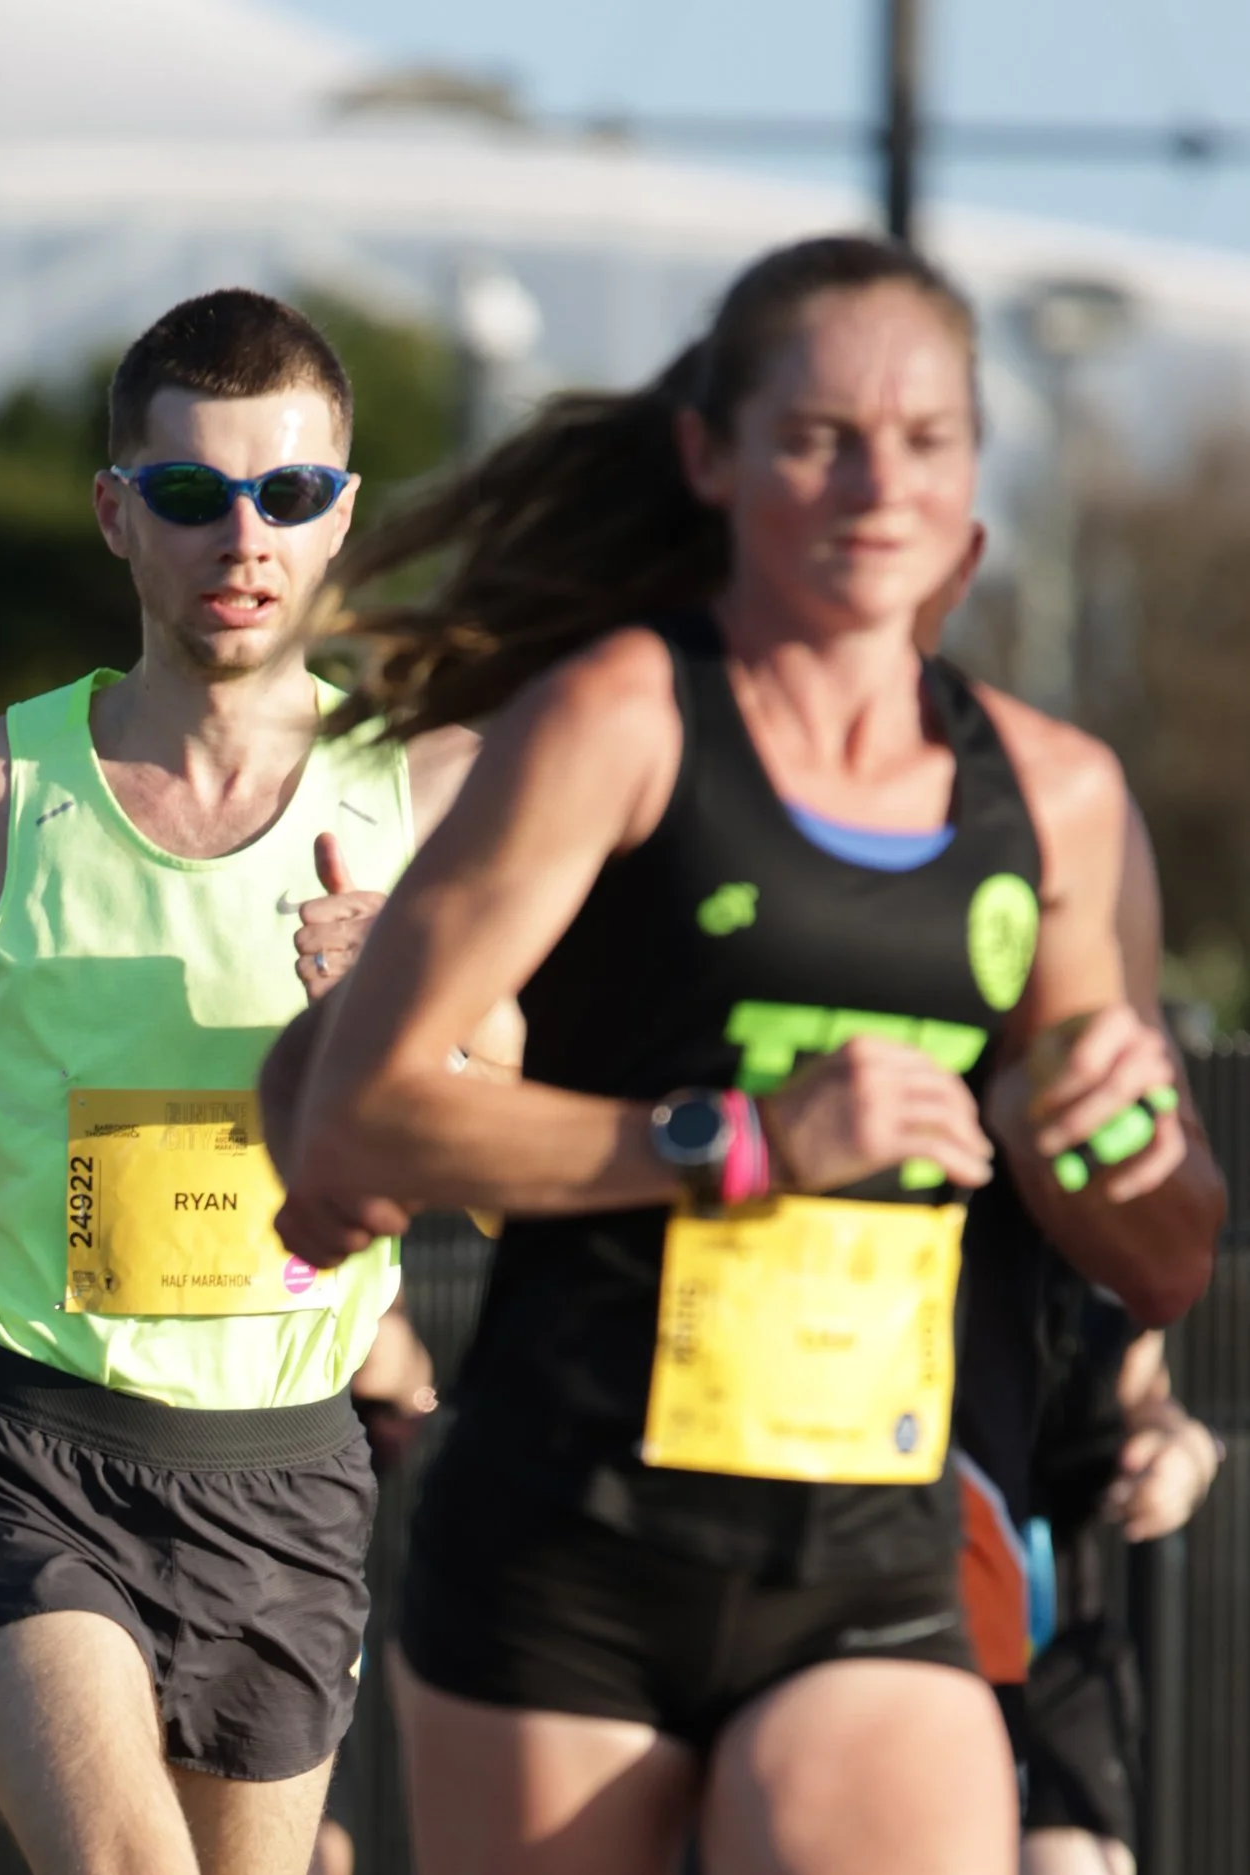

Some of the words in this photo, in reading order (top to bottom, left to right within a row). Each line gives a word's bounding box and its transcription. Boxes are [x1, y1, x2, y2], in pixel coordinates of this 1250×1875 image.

[70, 1156, 93, 1249] 24922
[174, 1193, 238, 1211] RYAN
[161, 1274, 187, 1288] HALF
[191, 1274, 252, 1288] MARATHON
